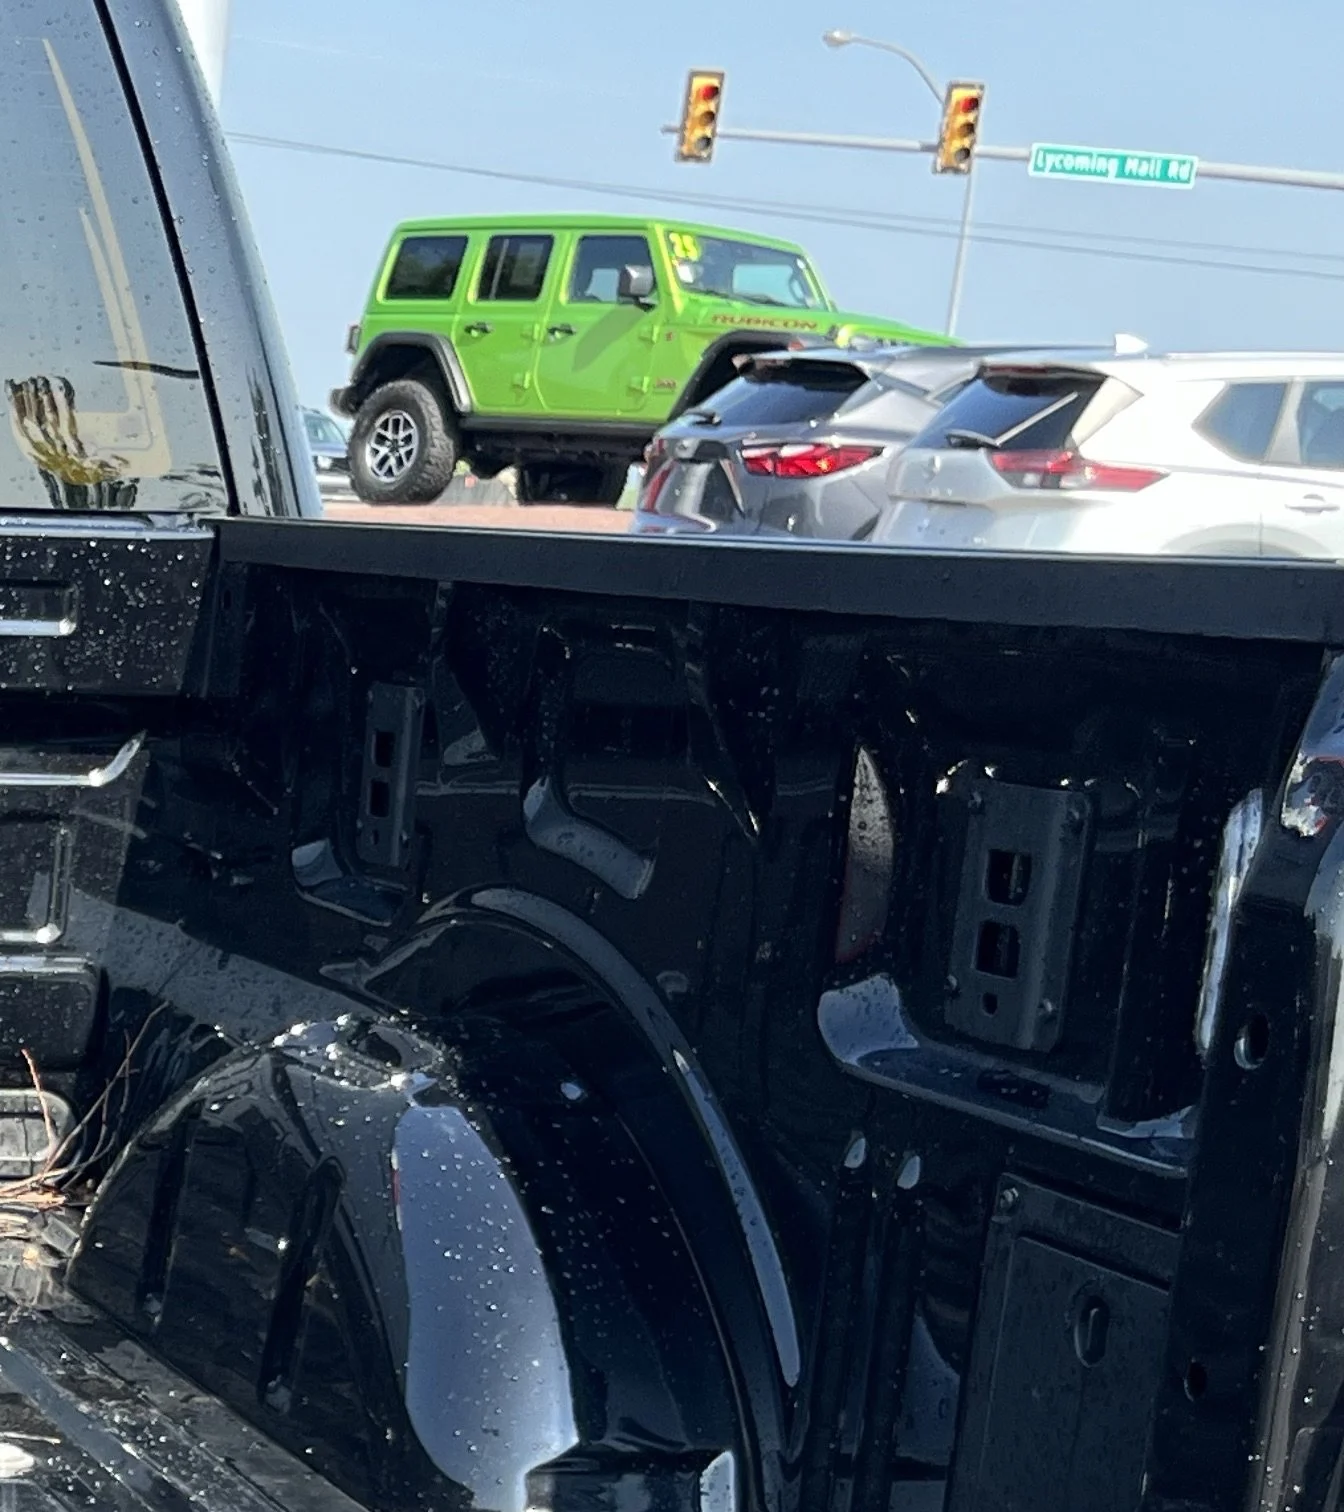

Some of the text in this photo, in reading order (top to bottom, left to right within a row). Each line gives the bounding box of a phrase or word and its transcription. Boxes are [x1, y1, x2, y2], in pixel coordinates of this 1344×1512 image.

[1036, 149, 1192, 181] Lycoming Mall Rd
[712, 313, 818, 331] RUBICON
